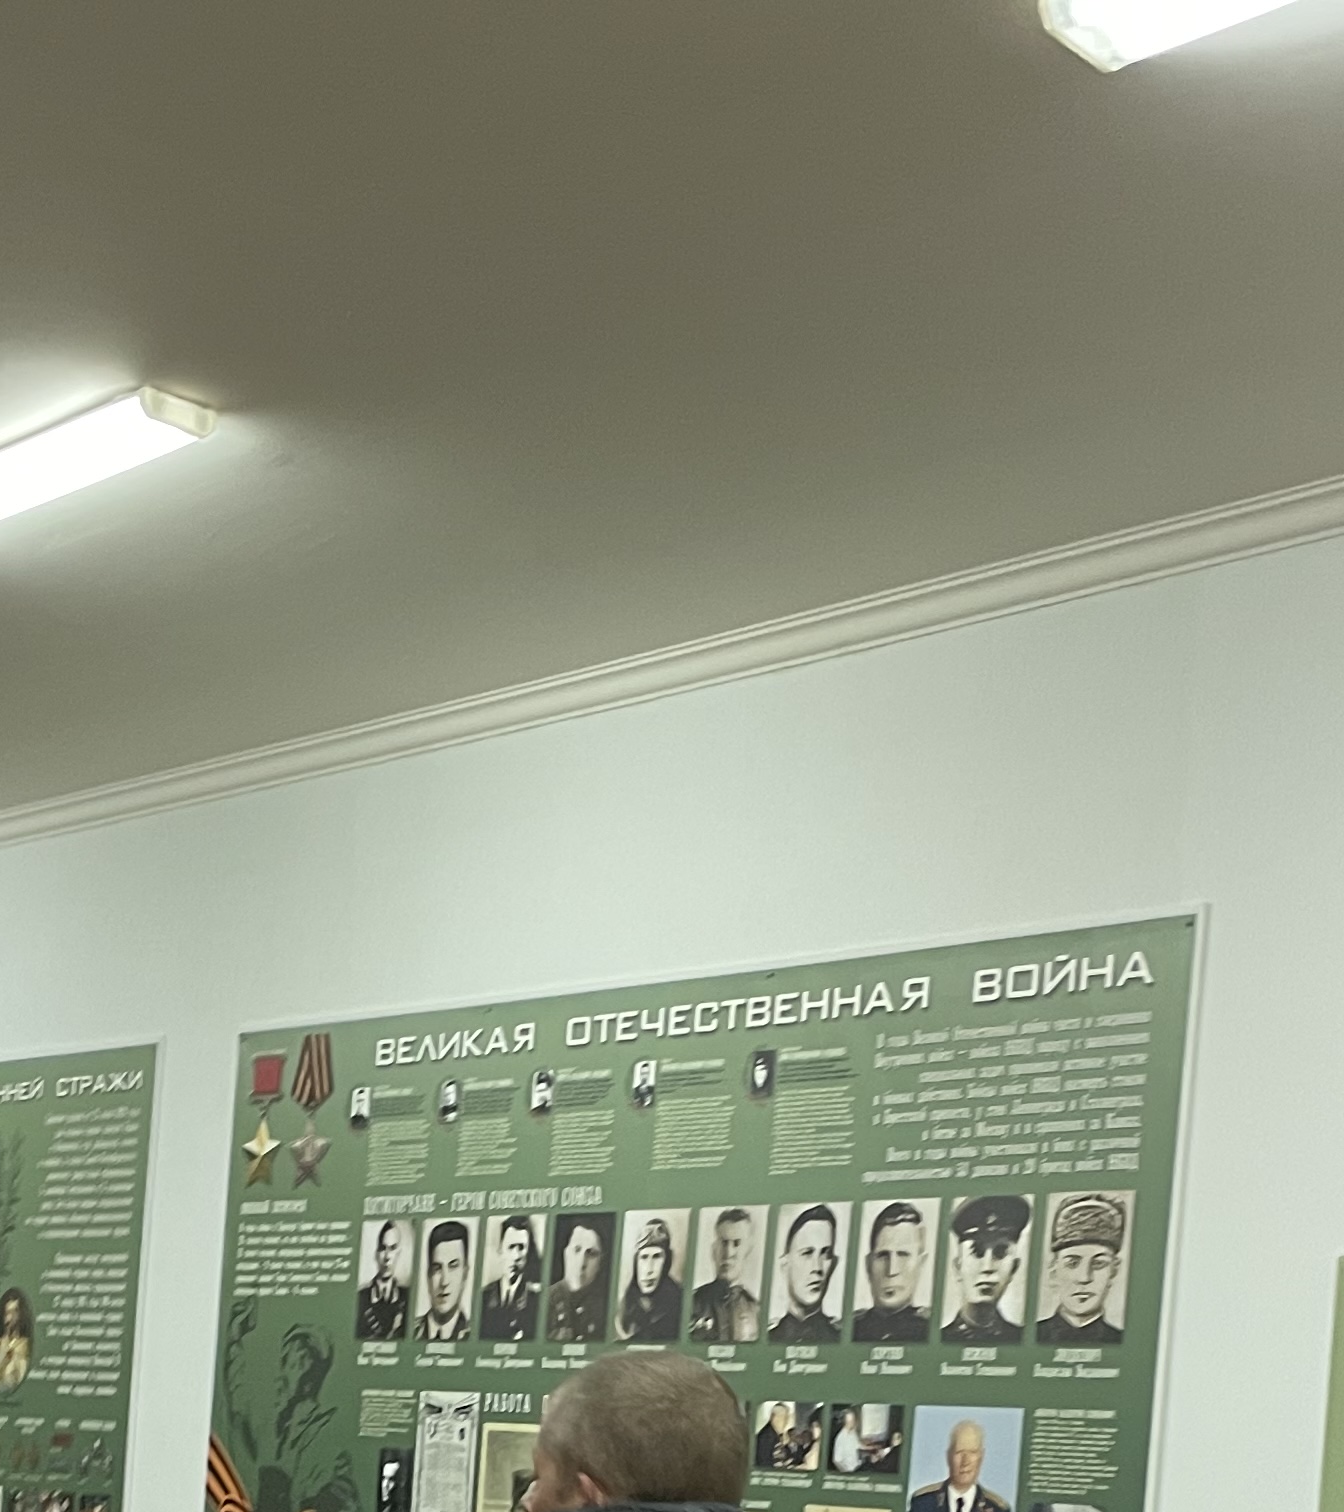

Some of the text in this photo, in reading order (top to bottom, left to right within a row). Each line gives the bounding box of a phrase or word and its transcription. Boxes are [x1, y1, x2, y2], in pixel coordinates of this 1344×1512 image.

[375, 951, 1154, 1067] ВЕЛИКАЯ ОТЕЧЕСТВЕННАЯ ВОЙНА
[56, 1070, 143, 1098] СТРАЖИ
[483, 1392, 532, 1413] РАБОТА
